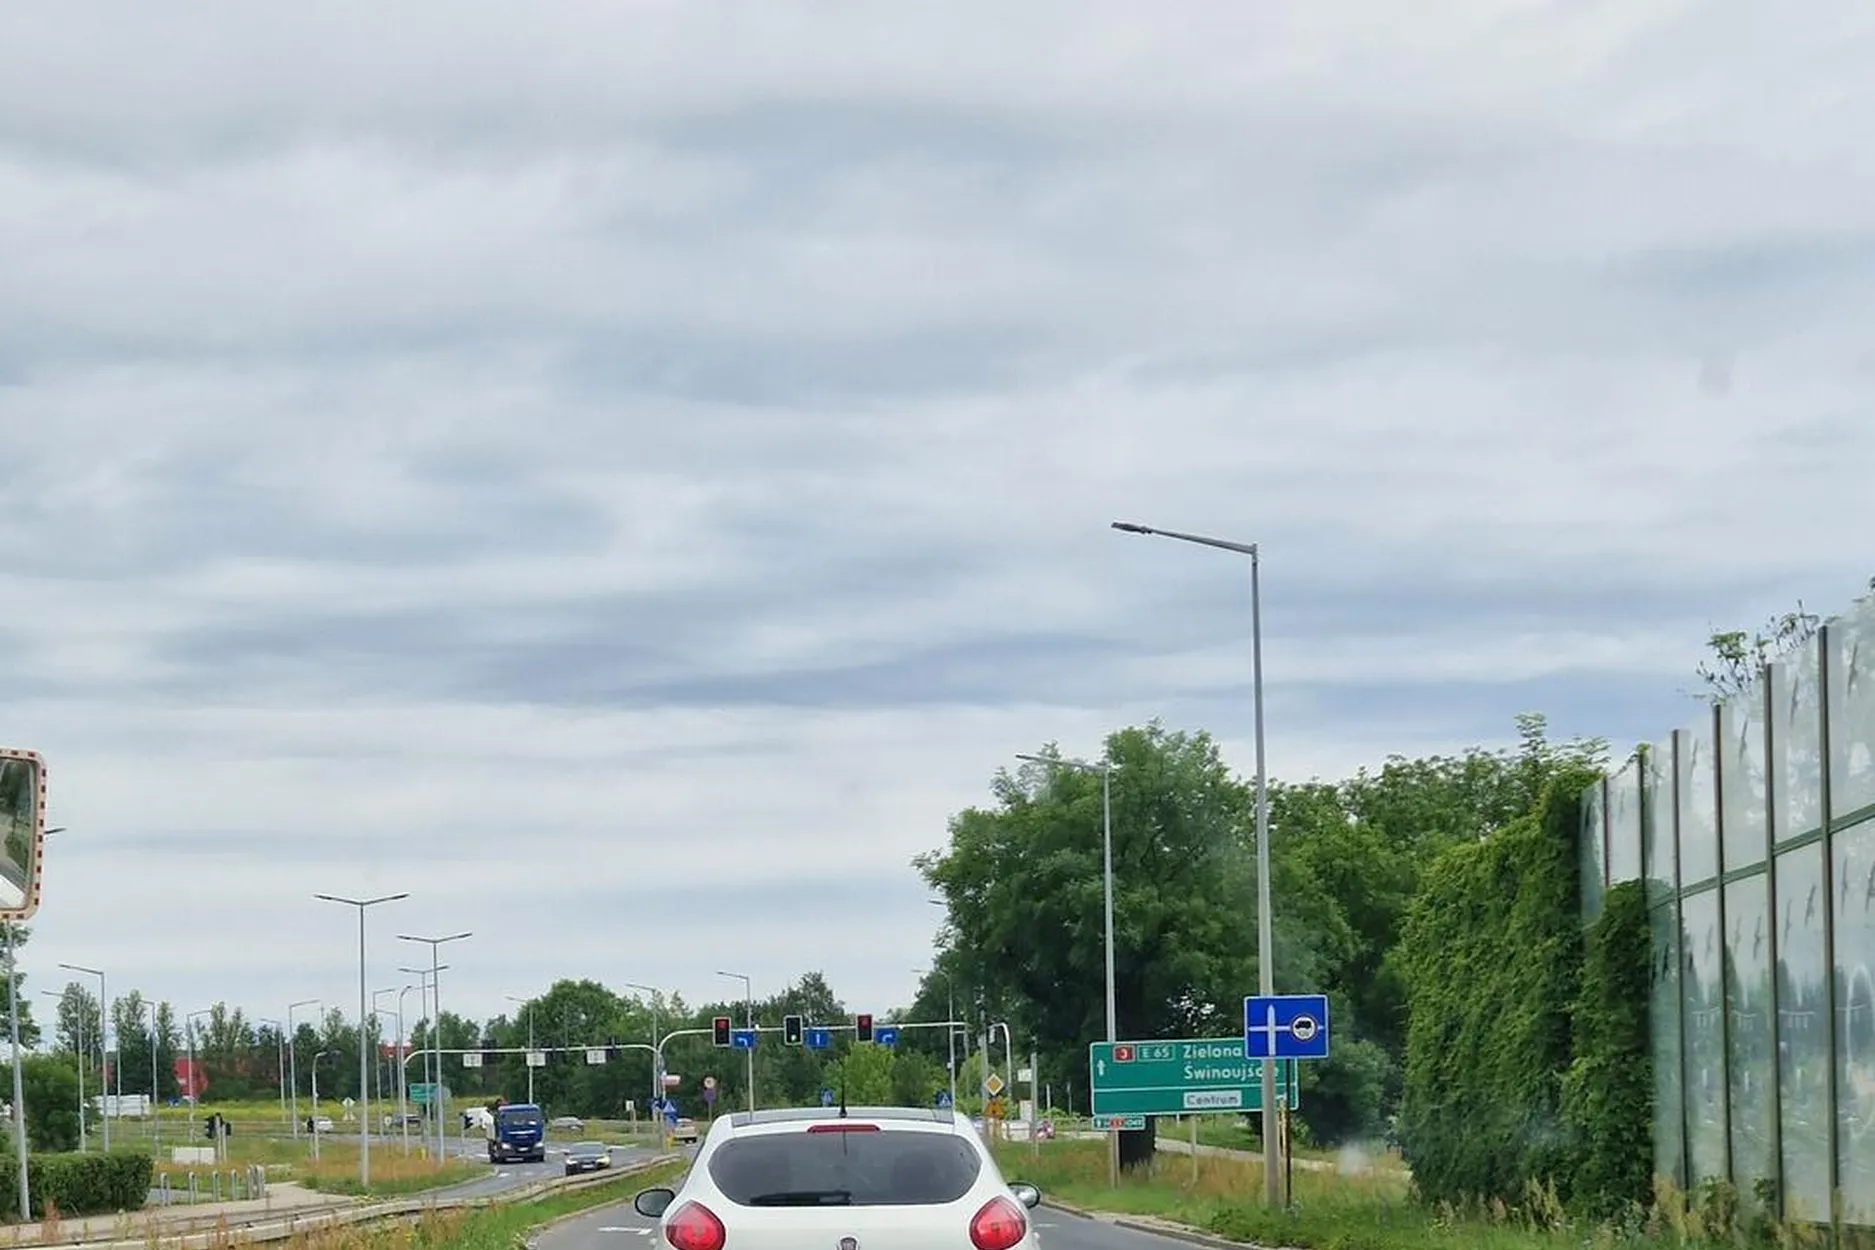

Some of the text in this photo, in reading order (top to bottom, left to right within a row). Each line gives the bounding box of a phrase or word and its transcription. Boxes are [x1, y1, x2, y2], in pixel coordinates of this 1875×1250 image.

[1120, 1048, 1128, 1059] 3
[1143, 1048, 1170, 1058] E 65
[1183, 1043, 1242, 1059] Zielona
[1184, 1060, 1279, 1081] Świnoujśce
[1187, 1095, 1239, 1106] Centrum
